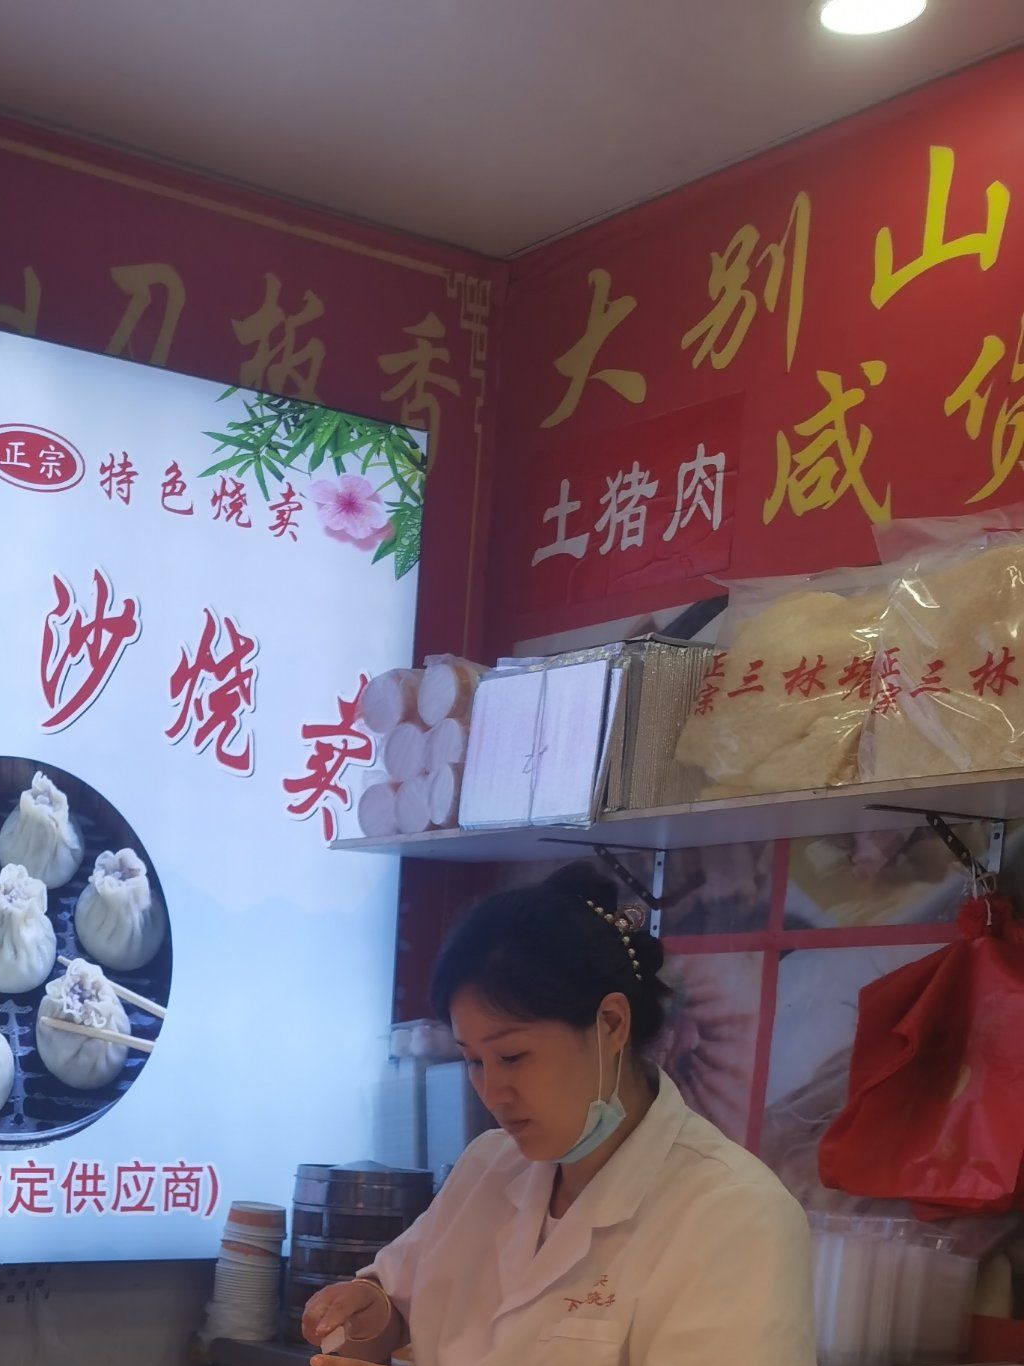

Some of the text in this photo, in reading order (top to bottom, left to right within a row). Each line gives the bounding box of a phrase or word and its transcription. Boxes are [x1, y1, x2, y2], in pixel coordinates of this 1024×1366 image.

[99, 450, 300, 543] 特色烧卖
[531, 443, 726, 567] 土猪肉
